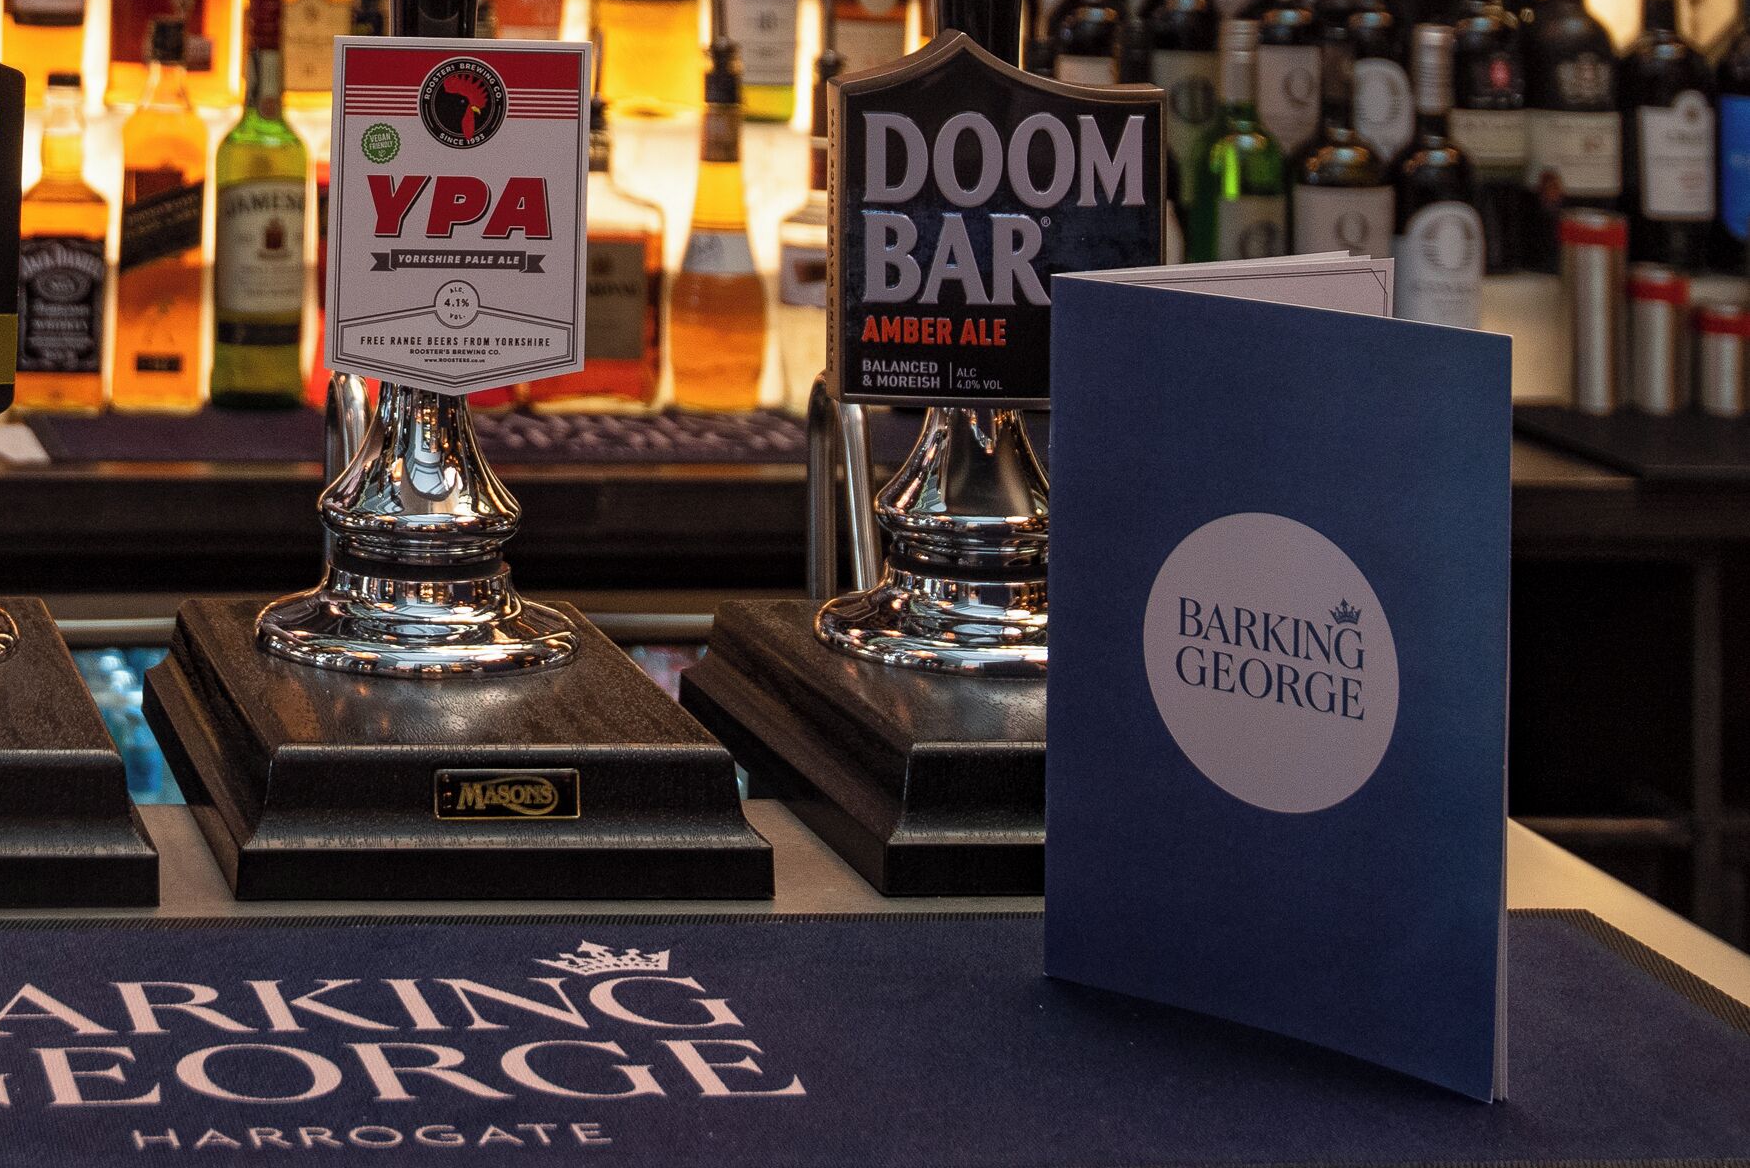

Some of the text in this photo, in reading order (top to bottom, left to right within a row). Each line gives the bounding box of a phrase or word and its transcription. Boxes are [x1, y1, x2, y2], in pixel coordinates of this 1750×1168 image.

[368, 139, 394, 150] FRIENDLY
[369, 132, 392, 143] VEGAN
[438, 132, 465, 146] SINCE
[861, 110, 1147, 209] DOOM
[366, 173, 553, 241] YPA
[398, 254, 521, 266] YORKSHIRE PALE ALE
[861, 209, 1051, 307] BAR
[443, 298, 470, 308] 4.1%
[861, 314, 1007, 346] AMBER ALE
[360, 335, 551, 348] FREE RANGE BEERS FROM YORKSHIRE
[409, 348, 501, 357] ROOSTER'S BREWING CO.
[861, 359, 939, 375] BALANCED
[956, 367, 978, 378] ALC
[861, 375, 941, 390] & MOREISH
[956, 379, 1003, 390] 4.0% VOL
[1177, 596, 1365, 672] BARKING
[1175, 645, 1365, 721] GEORGE
[456, 782, 553, 811] MASONS
[131, 1121, 613, 1152] HARROGATE
